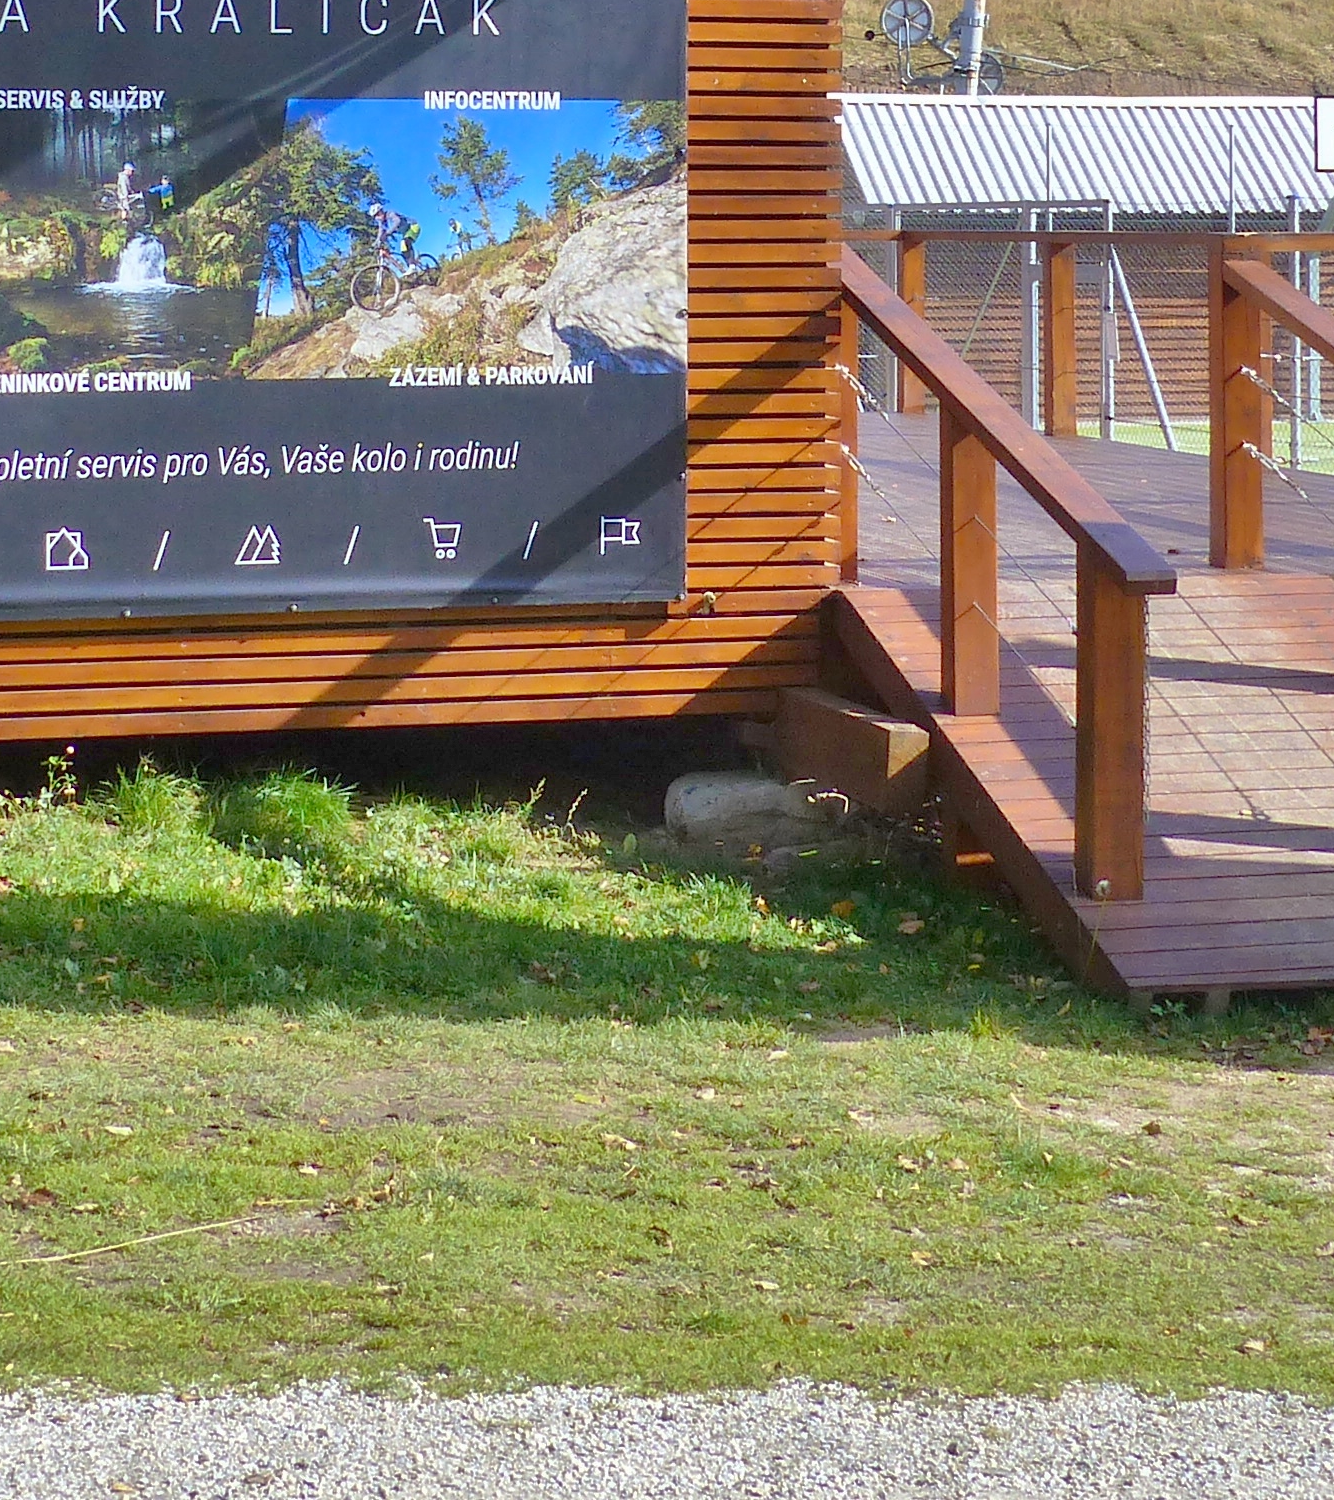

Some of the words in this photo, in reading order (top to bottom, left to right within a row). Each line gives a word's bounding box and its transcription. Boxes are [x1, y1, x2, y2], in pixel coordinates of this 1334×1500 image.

[68, 88, 85, 111] &
[88, 84, 166, 112] SLUŽBY
[423, 89, 562, 111] INFOCENTRUM
[93, 370, 192, 393] CENTRUM
[387, 361, 462, 387] ZÁZEMÍ
[465, 365, 482, 386] &
[487, 358, 595, 386] PARKOVÁNÍ
[75, 448, 157, 479] servis
[161, 453, 209, 484] pro
[216, 445, 272, 480] Vás,
[279, 443, 345, 475] Vaše
[350, 442, 407, 473] kolo
[412, 442, 424, 471] i
[427, 440, 520, 471] rodinu!
